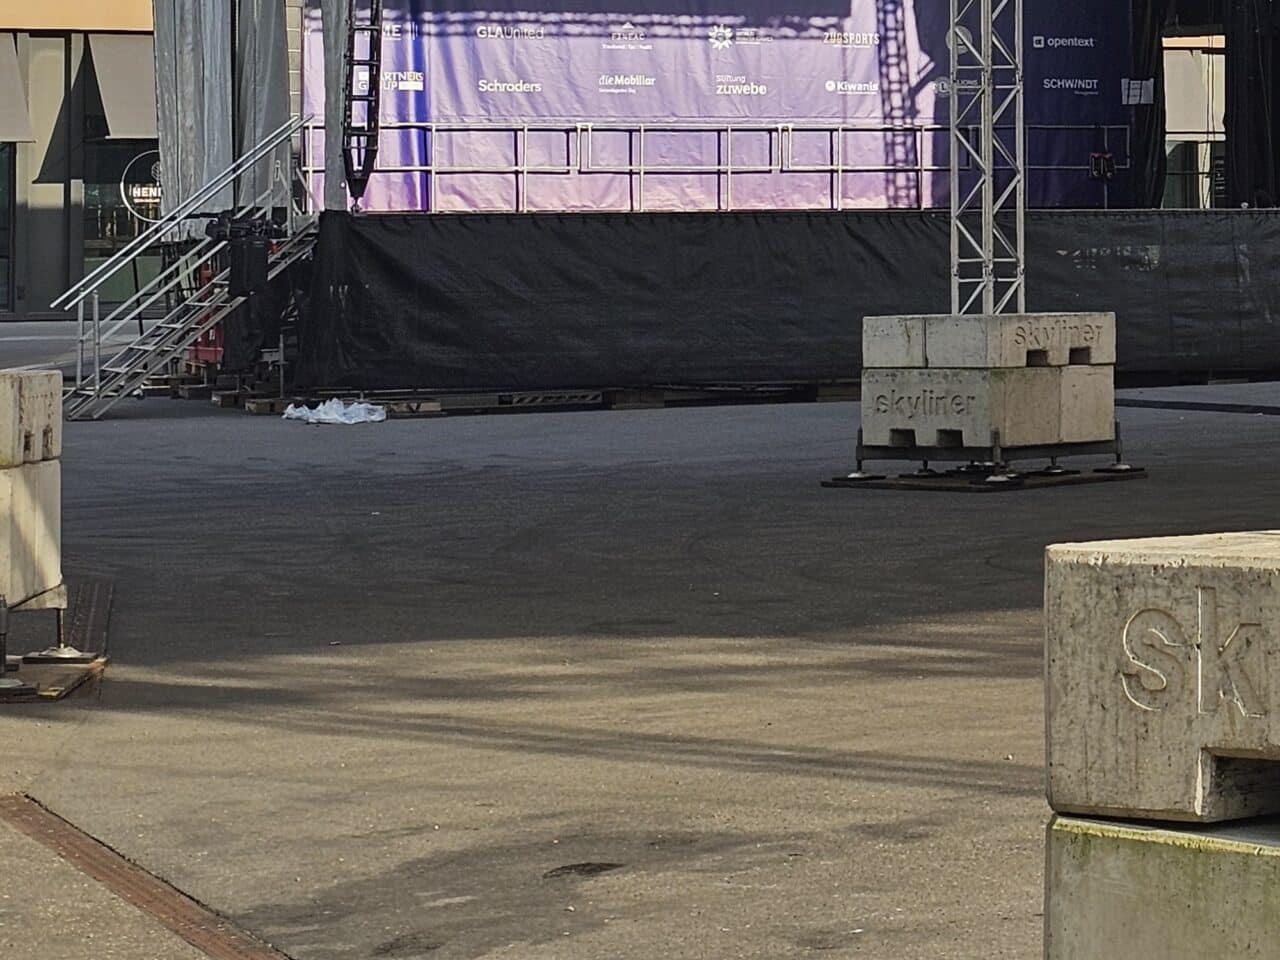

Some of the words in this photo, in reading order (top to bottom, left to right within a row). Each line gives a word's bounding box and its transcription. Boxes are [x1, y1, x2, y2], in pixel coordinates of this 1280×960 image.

[1047, 37, 1095, 48] opentext
[478, 79, 542, 93] Schroders
[716, 82, 767, 95] zuwebe
[836, 81, 879, 92] Kiwanis
[1014, 319, 1104, 346] skyliner
[874, 390, 976, 419] skyliner
